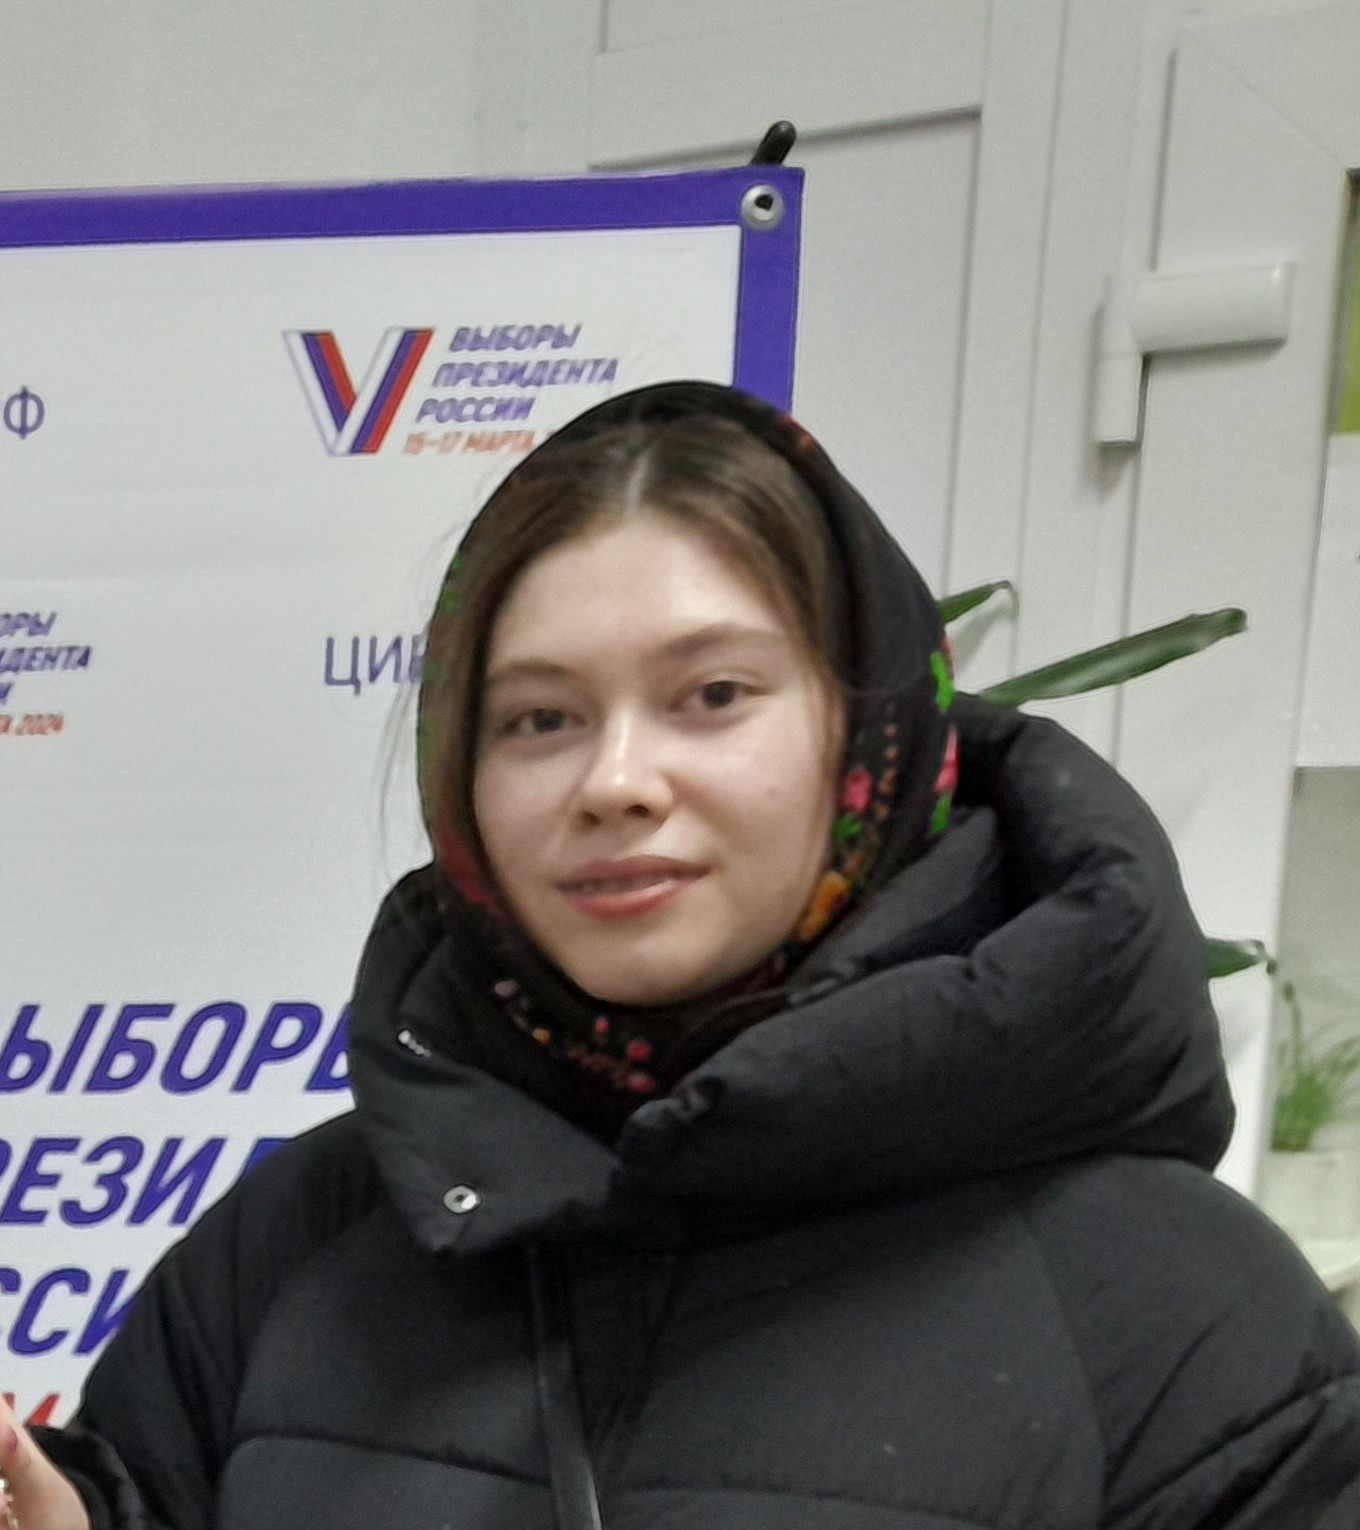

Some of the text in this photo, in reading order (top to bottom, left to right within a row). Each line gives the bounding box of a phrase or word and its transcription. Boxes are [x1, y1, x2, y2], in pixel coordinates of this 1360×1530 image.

[449, 324, 582, 352] ВЫБОРЫ
[432, 358, 618, 388] ПРЕЗИДЕНТА
[415, 396, 537, 424] РОССИИ
